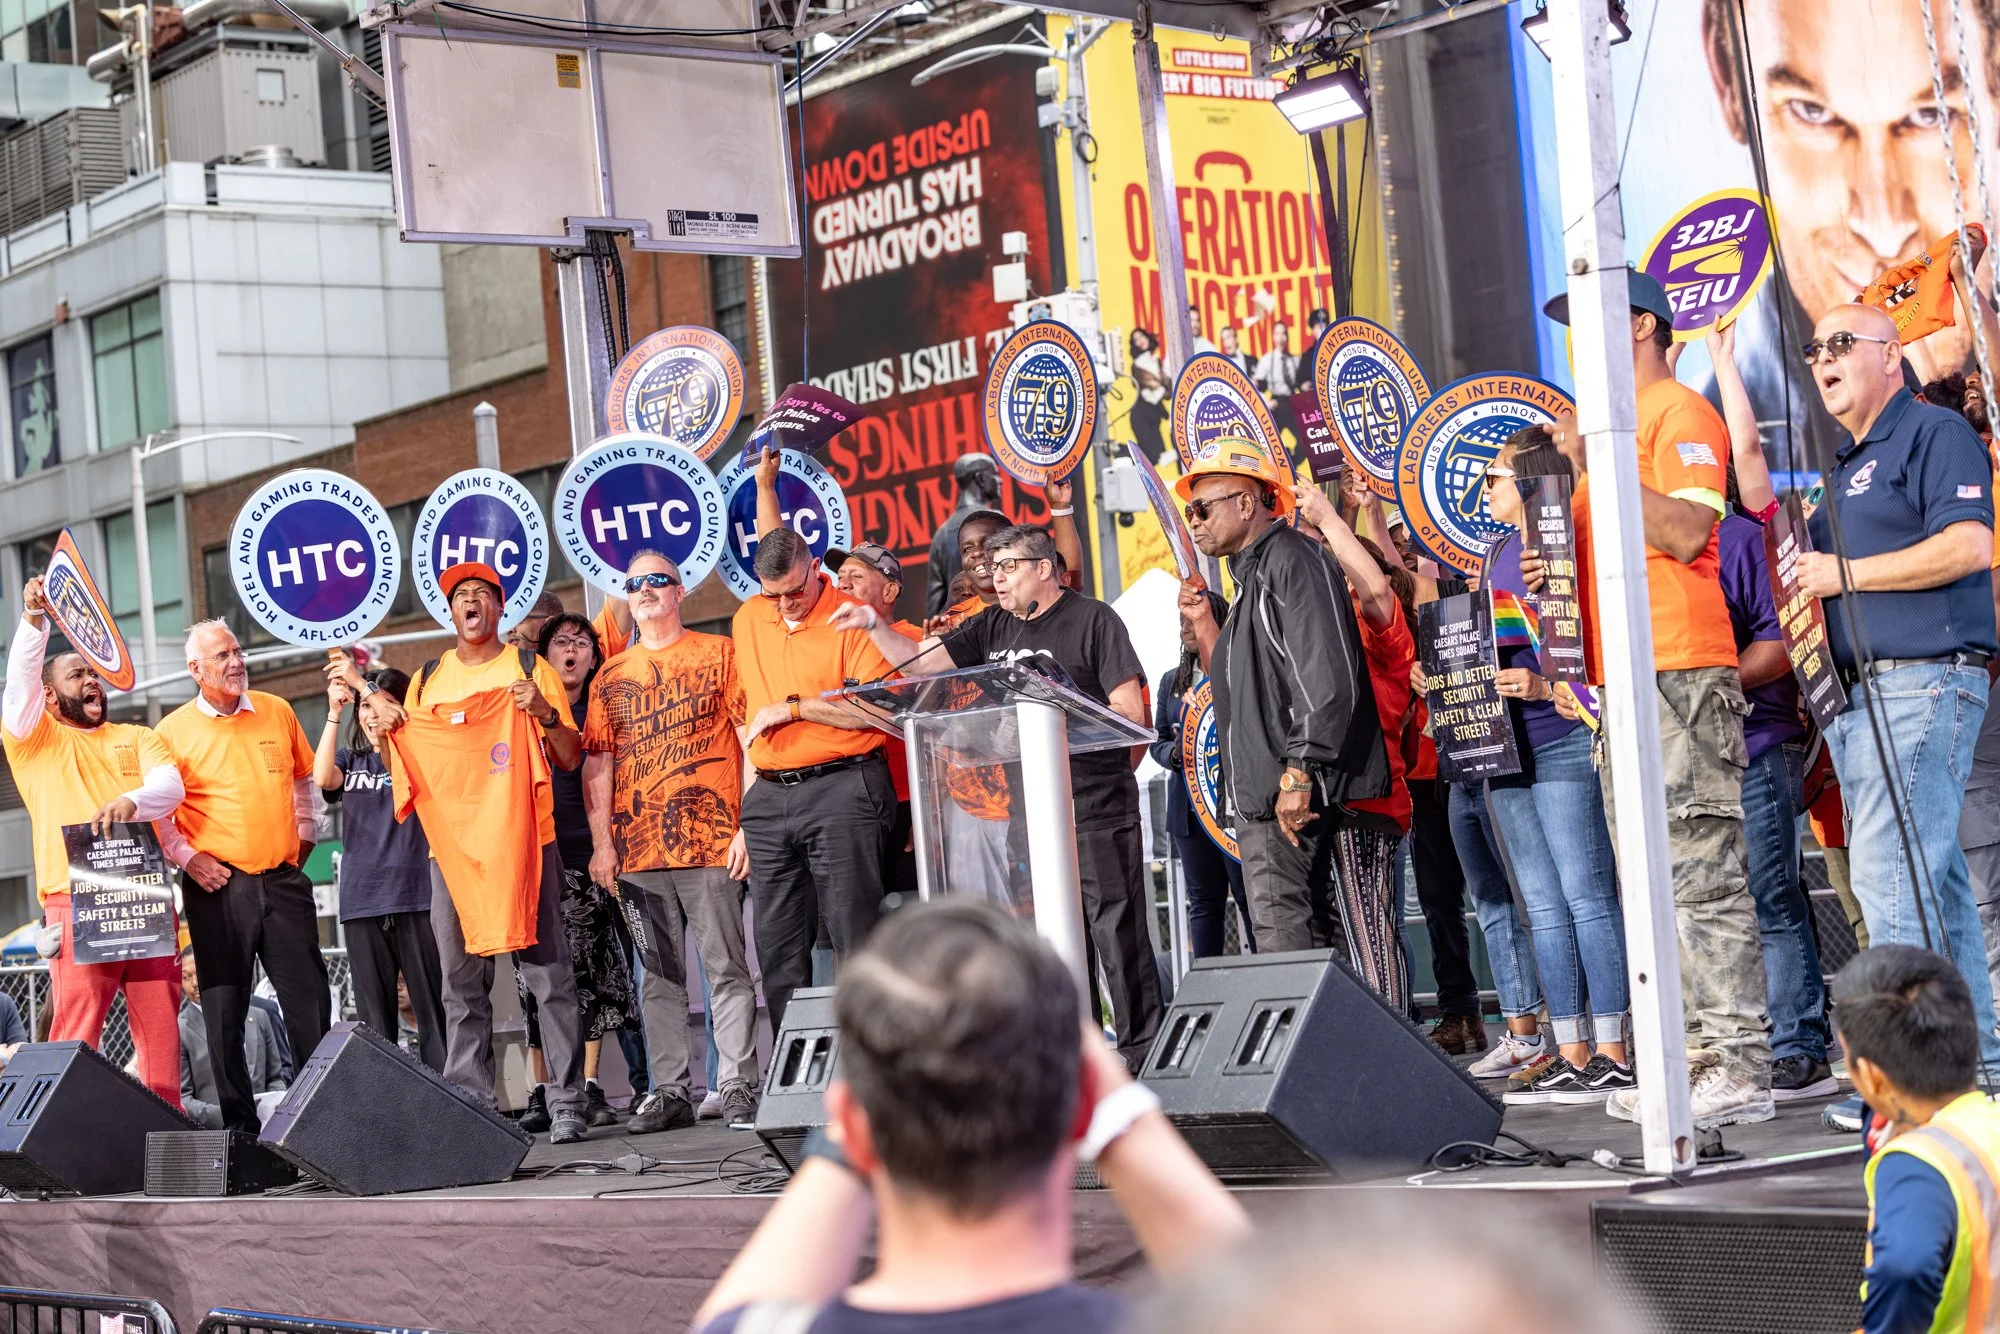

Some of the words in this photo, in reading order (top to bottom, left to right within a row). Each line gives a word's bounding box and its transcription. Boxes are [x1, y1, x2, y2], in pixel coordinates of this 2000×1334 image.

[1175, 50, 1212, 68] LITTLE
[1161, 71, 1191, 94] ERY
[1192, 73, 1222, 96] BIG
[892, 108, 991, 176] UPSIDE
[805, 142, 888, 204] DOWN
[920, 157, 983, 213] HAS
[708, 212, 719, 220] SL
[721, 212, 736, 221] 100
[813, 178, 919, 245] TURNED
[1123, 182, 1332, 278] OERATION
[1670, 208, 1756, 250] 32BJ
[821, 204, 982, 290] BROADWAY
[1666, 274, 1741, 313] SEIU
[900, 336, 979, 395] FIRST
[1327, 325, 1405, 367] INTERNATIONAL
[612, 363, 633, 431] ABORERS'
[633, 332, 727, 364] INTERNATIONAL
[727, 357, 741, 397] UNION
[628, 380, 641, 422] JUSTICE
[654, 350, 686, 365] HONOR
[988, 342, 1017, 419] LABORERS'
[1019, 327, 1086, 376] INTERNATIONAL
[1085, 379, 1096, 426] UNION
[1002, 361, 1020, 405] JUSTICE
[1034, 347, 1059, 355] HONOR
[1068, 362, 1082, 411] STRENGTH
[1318, 352, 1340, 443] LABORERS'
[1330, 373, 1342, 424] JUSTICE
[1342, 346, 1368, 359] HONOR
[1381, 357, 1415, 409] STRENGTH
[1408, 367, 1430, 407] UNIO
[639, 371, 718, 439] 79
[769, 420, 805, 431] Square.
[783, 408, 820, 423] Palace
[811, 401, 832, 414] Yes
[832, 411, 846, 421] to
[1013, 373, 1077, 437] 79
[1185, 361, 1258, 411] INTERNATIONAL
[1261, 413, 1288, 468] UNION
[1188, 411, 1198, 456] USTICE
[1200, 384, 1224, 396] HONOR
[1237, 398, 1266, 448] STRENGT
[1338, 378, 1404, 453] 79
[828, 393, 992, 489] HINGS
[1012, 439, 1038, 460] Organized
[1403, 393, 1460, 485] LABORERS'
[1426, 418, 1464, 471] JUSTICE
[1491, 404, 1538, 422] HONOR
[575, 447, 637, 485] GAMING
[645, 447, 706, 486] TRADES
[1000, 448, 1011, 460] of
[1010, 456, 1039, 478] North
[251, 481, 313, 522] GAMING
[320, 481, 379, 524] TRADES
[438, 476, 492, 505] GAMING
[498, 480, 539, 530] TRADES
[563, 489, 577, 522] AND
[1372, 479, 1395, 498] Nort
[420, 509, 437, 543] AND
[591, 499, 692, 544] HTC
[696, 491, 719, 563] COUNCIL
[720, 552, 749, 593] HOTE
[780, 453, 829, 492] RADES
[828, 496, 843, 546] COUN
[1439, 517, 1481, 551] Organized
[240, 527, 254, 565] AND
[267, 539, 366, 588] HTC
[439, 534, 520, 577] HTC
[565, 528, 601, 577] HOTEL
[1421, 526, 1439, 541] of
[1436, 542, 1480, 571] North
[371, 530, 393, 605] COUNCIL
[418, 550, 438, 602] HOTEL
[515, 537, 543, 609] COUNCIL
[242, 572, 278, 623] HOTEL
[299, 621, 359, 641] AFL-CIO
[1434, 636, 1458, 649] CAESARS
[1459, 630, 1480, 644] PALACE
[1439, 624, 1448, 636] WE
[1449, 619, 1473, 634] SUPPORT
[1438, 649, 1455, 661] TIMES
[1456, 645, 1478, 657] SQUARE
[631, 675, 691, 721] LOCAL
[696, 664, 722, 695] 79
[1425, 673, 1445, 692] JOBS
[1447, 671, 1464, 688] AND
[1466, 665, 1495, 684] BETTER
[1443, 684, 1486, 705] SECURITY!
[658, 699, 694, 732] YORK
[1435, 708, 1465, 727] SAFETY
[1468, 708, 1475, 720] &
[1476, 701, 1503, 719] CLEAN
[1454, 723, 1491, 741] STREETS
[634, 758, 657, 784] the
[657, 733, 715, 772] Power
[635, 722, 693, 759] ESTABLISHED
[1184, 719, 1206, 816] LABORERS'
[86, 850, 118, 861] CAESARS
[119, 846, 145, 857] PALACE
[92, 841, 104, 850] WE
[105, 838, 135, 849] SUPPORT
[92, 860, 113, 870] TIMES
[115, 855, 143, 866] SQUARE
[1227, 841, 1237, 854] of
[73, 880, 99, 895] JOBS
[123, 872, 164, 887] BETTER
[94, 889, 148, 906] SECURITY!
[78, 908, 118, 922] SAFETY
[120, 907, 129, 918] &
[132, 902, 166, 917] CLEAN
[100, 918, 146, 933] STREETS
